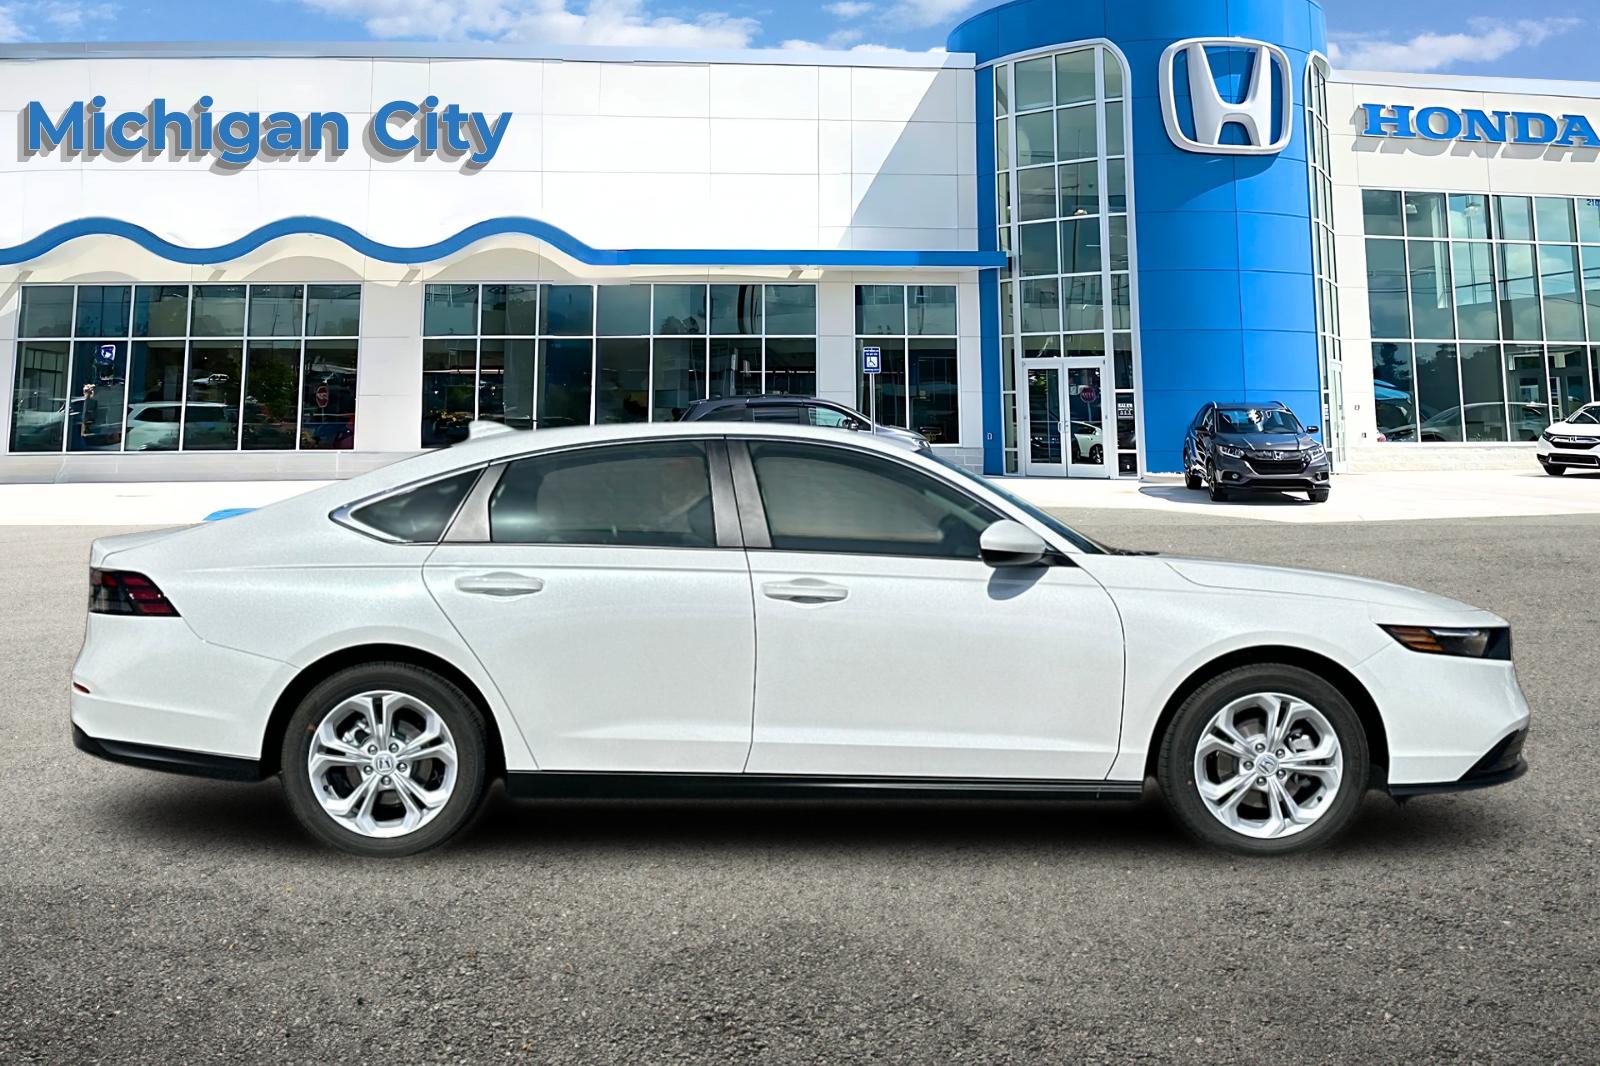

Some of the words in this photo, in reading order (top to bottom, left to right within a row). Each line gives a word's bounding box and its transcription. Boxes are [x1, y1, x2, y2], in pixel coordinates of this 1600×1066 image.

[28, 95, 350, 164] Michigan
[373, 95, 513, 164] City
[1361, 103, 1600, 147] HONDA
